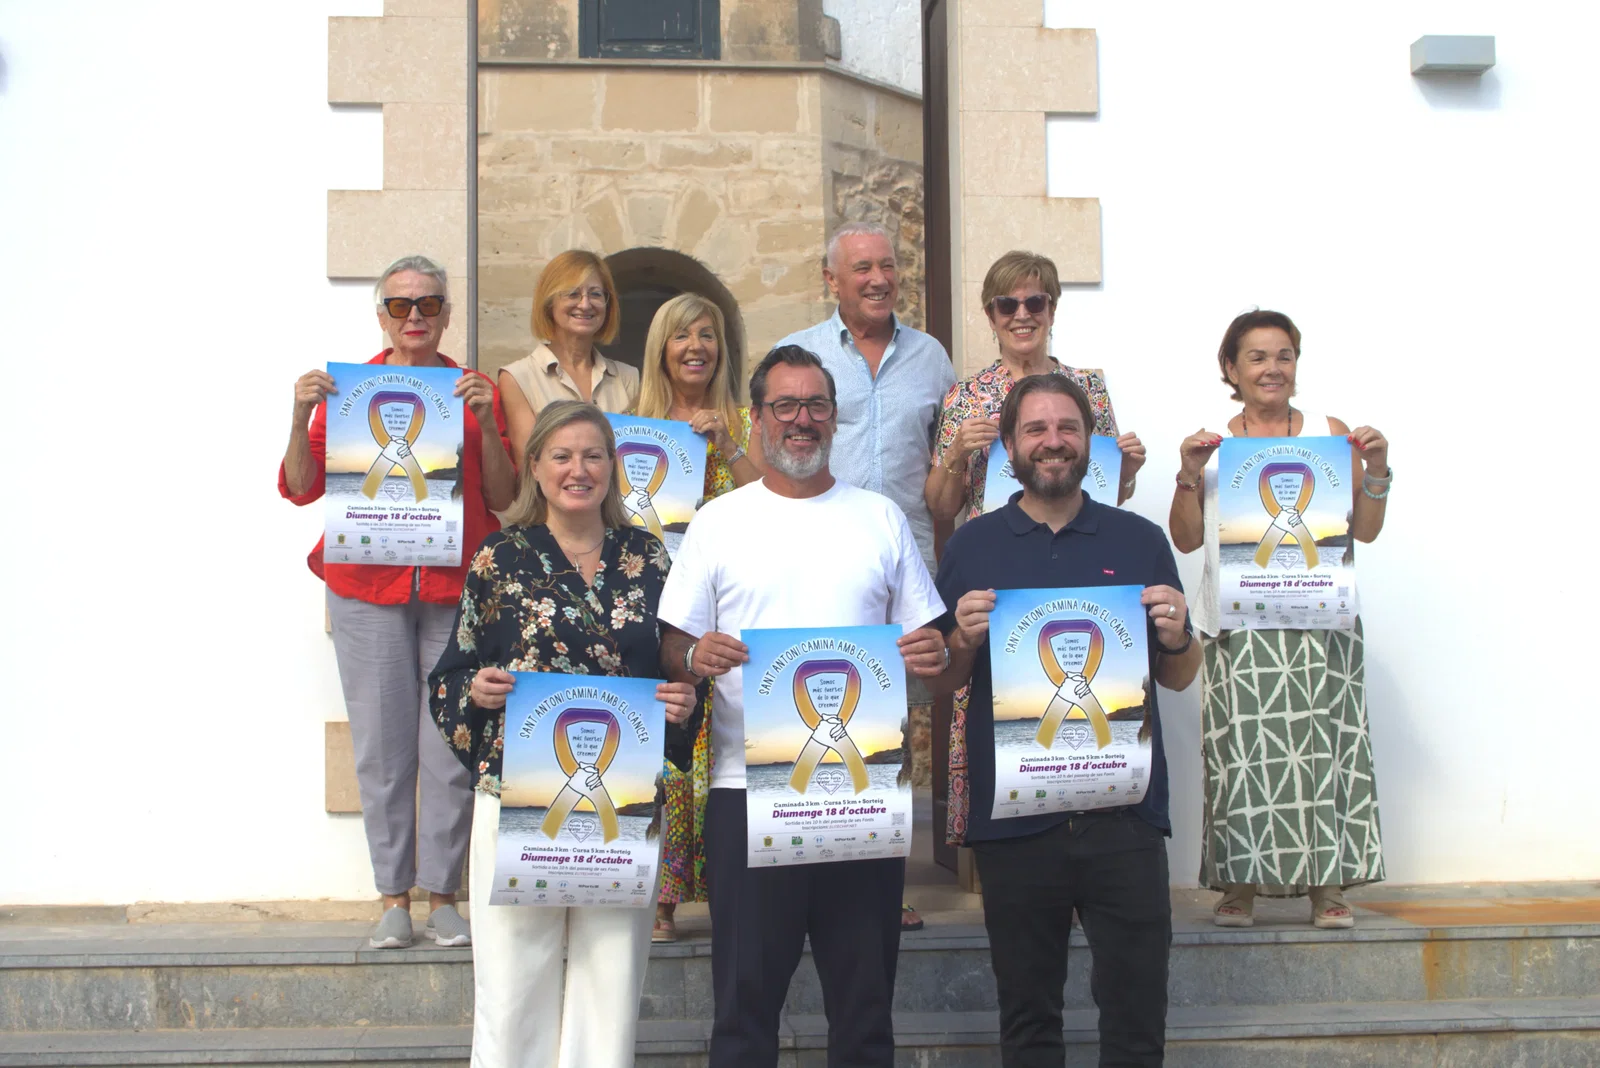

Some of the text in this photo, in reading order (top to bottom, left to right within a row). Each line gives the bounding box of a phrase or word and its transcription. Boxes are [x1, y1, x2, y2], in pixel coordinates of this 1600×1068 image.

[340, 398, 354, 416] SANT
[352, 379, 376, 398] ANTONI
[378, 375, 404, 385] CAMINA
[408, 378, 422, 390] AMB
[423, 386, 432, 396] EL
[624, 427, 651, 436] CAMINA
[653, 430, 668, 444] AMB
[668, 440, 677, 450] EL
[1232, 471, 1244, 489] SANT
[1243, 452, 1266, 472] ANTONI
[1267, 447, 1294, 456] CAMINA
[1296, 448, 1311, 459] AMB
[1312, 454, 1320, 464] EL
[346, 512, 388, 521] Diumenge
[402, 512, 441, 520] d'octubre
[1240, 580, 1281, 589] Diumenge
[1005, 632, 1020, 653] SANT
[1019, 607, 1045, 632] ANTONI
[1046, 600, 1078, 613] CAMINA
[1081, 602, 1099, 615] AMB
[1100, 610, 1109, 622] EL
[759, 672, 774, 695] SANT
[773, 648, 801, 672] ANTONI
[802, 639, 834, 653] CAMINA
[838, 641, 856, 655] AMB
[857, 650, 866, 662] EL
[520, 716, 537, 738] SANT
[537, 693, 563, 718] ANTONI
[566, 689, 597, 700] CAMINA
[601, 691, 618, 707] AMB
[618, 701, 626, 714] EL
[1020, 763, 1067, 773] Diumenge
[1083, 761, 1127, 769] d'octubre
[773, 809, 822, 819] Diumenge
[839, 806, 886, 815] d'octubre
[521, 853, 570, 863] Diumenge
[587, 855, 632, 864] d'octubre
